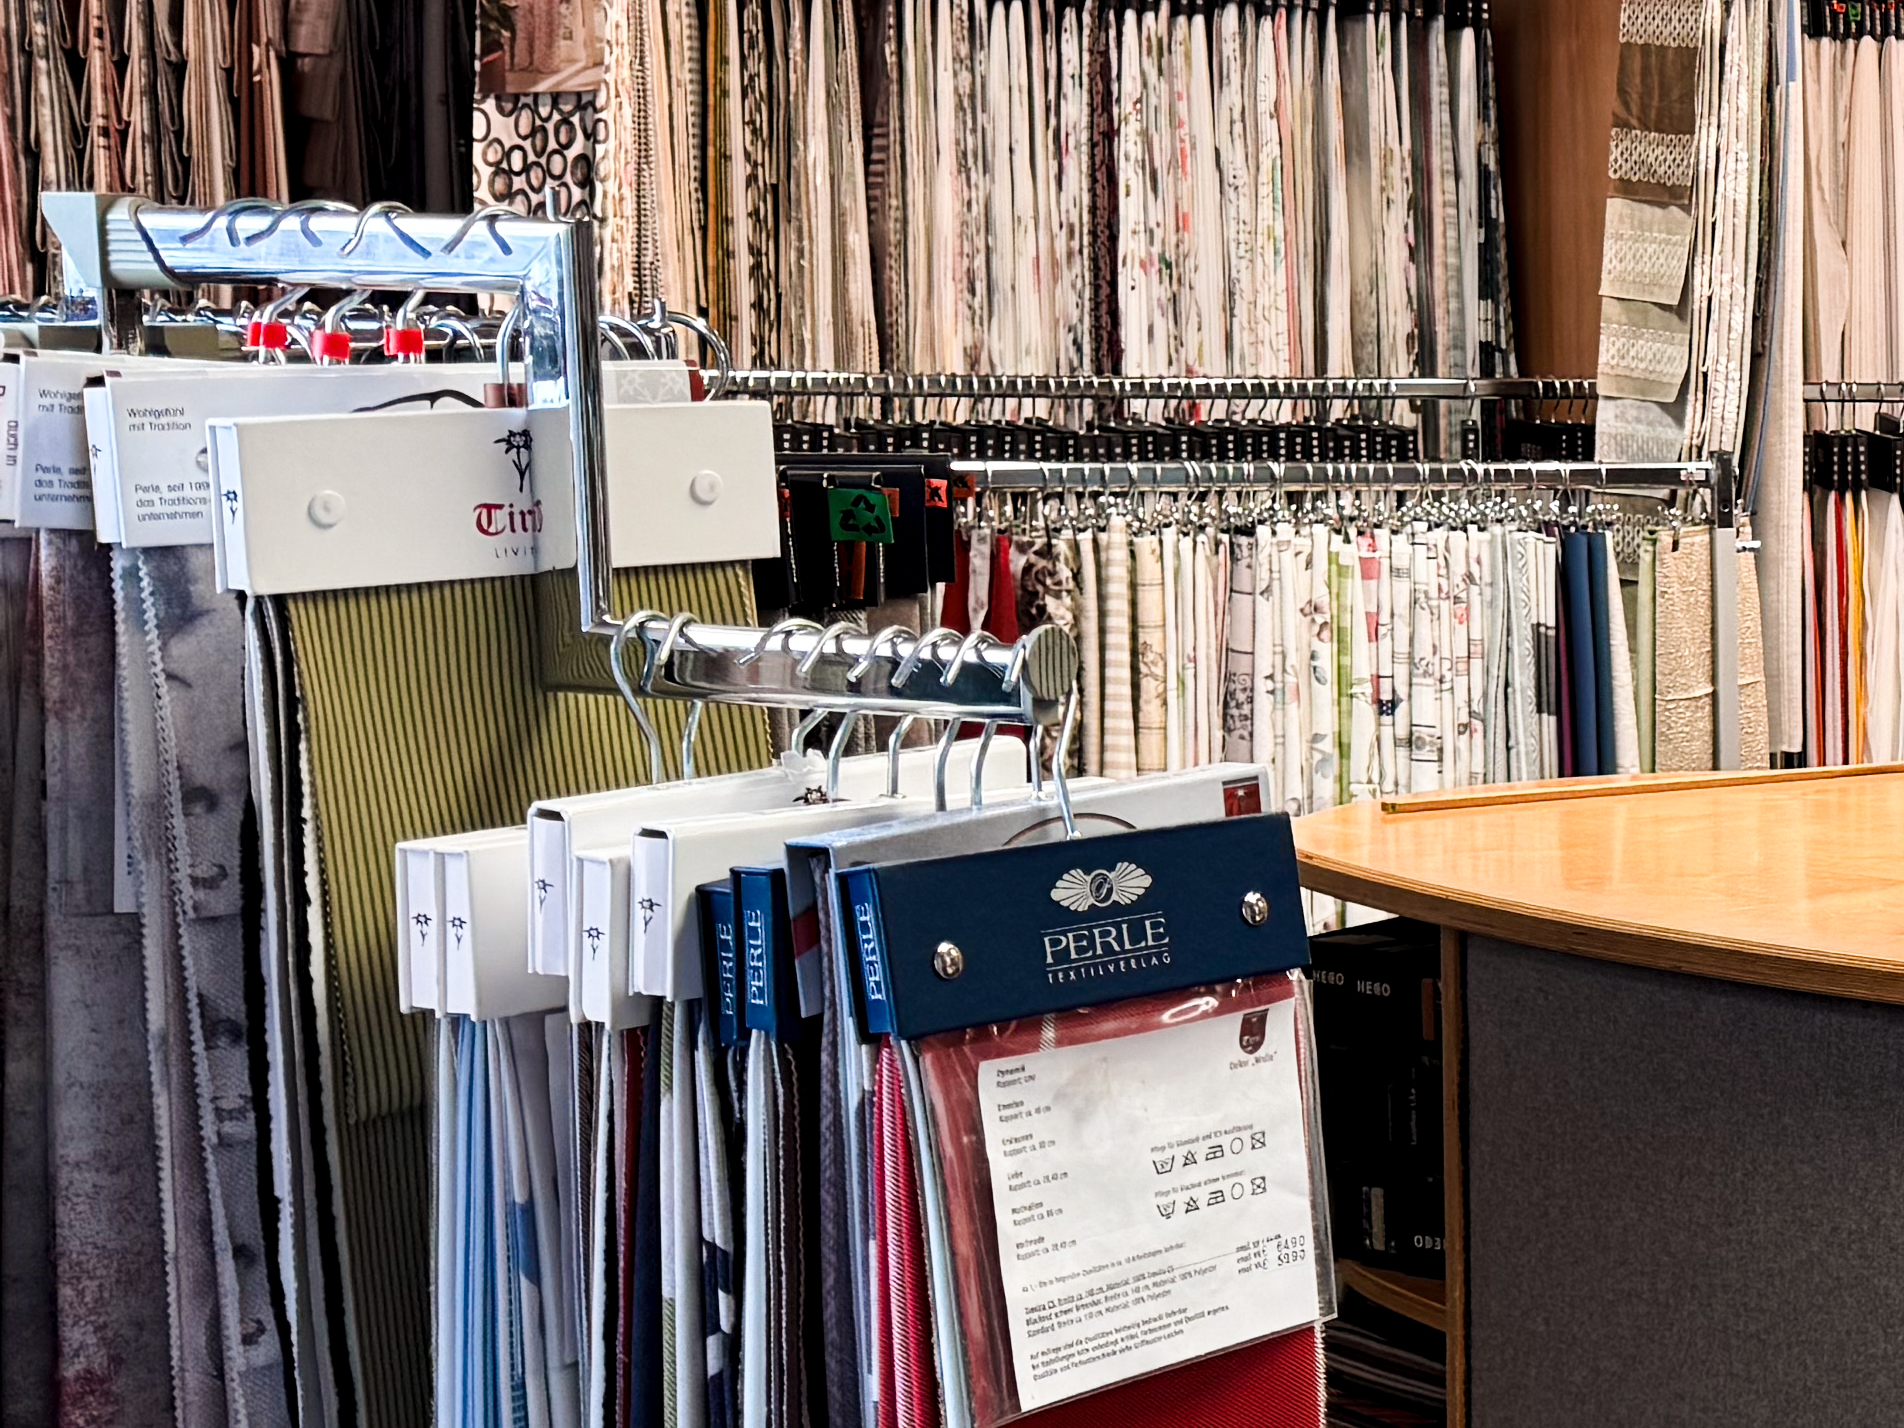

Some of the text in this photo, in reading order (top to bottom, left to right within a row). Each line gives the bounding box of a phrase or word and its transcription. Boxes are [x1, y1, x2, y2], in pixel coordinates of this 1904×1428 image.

[748, 909, 765, 1006] PERLE
[855, 902, 884, 1001] PERLE
[1043, 917, 1170, 965] PERLE
[1047, 952, 1171, 984] TEXTILVERLAG
